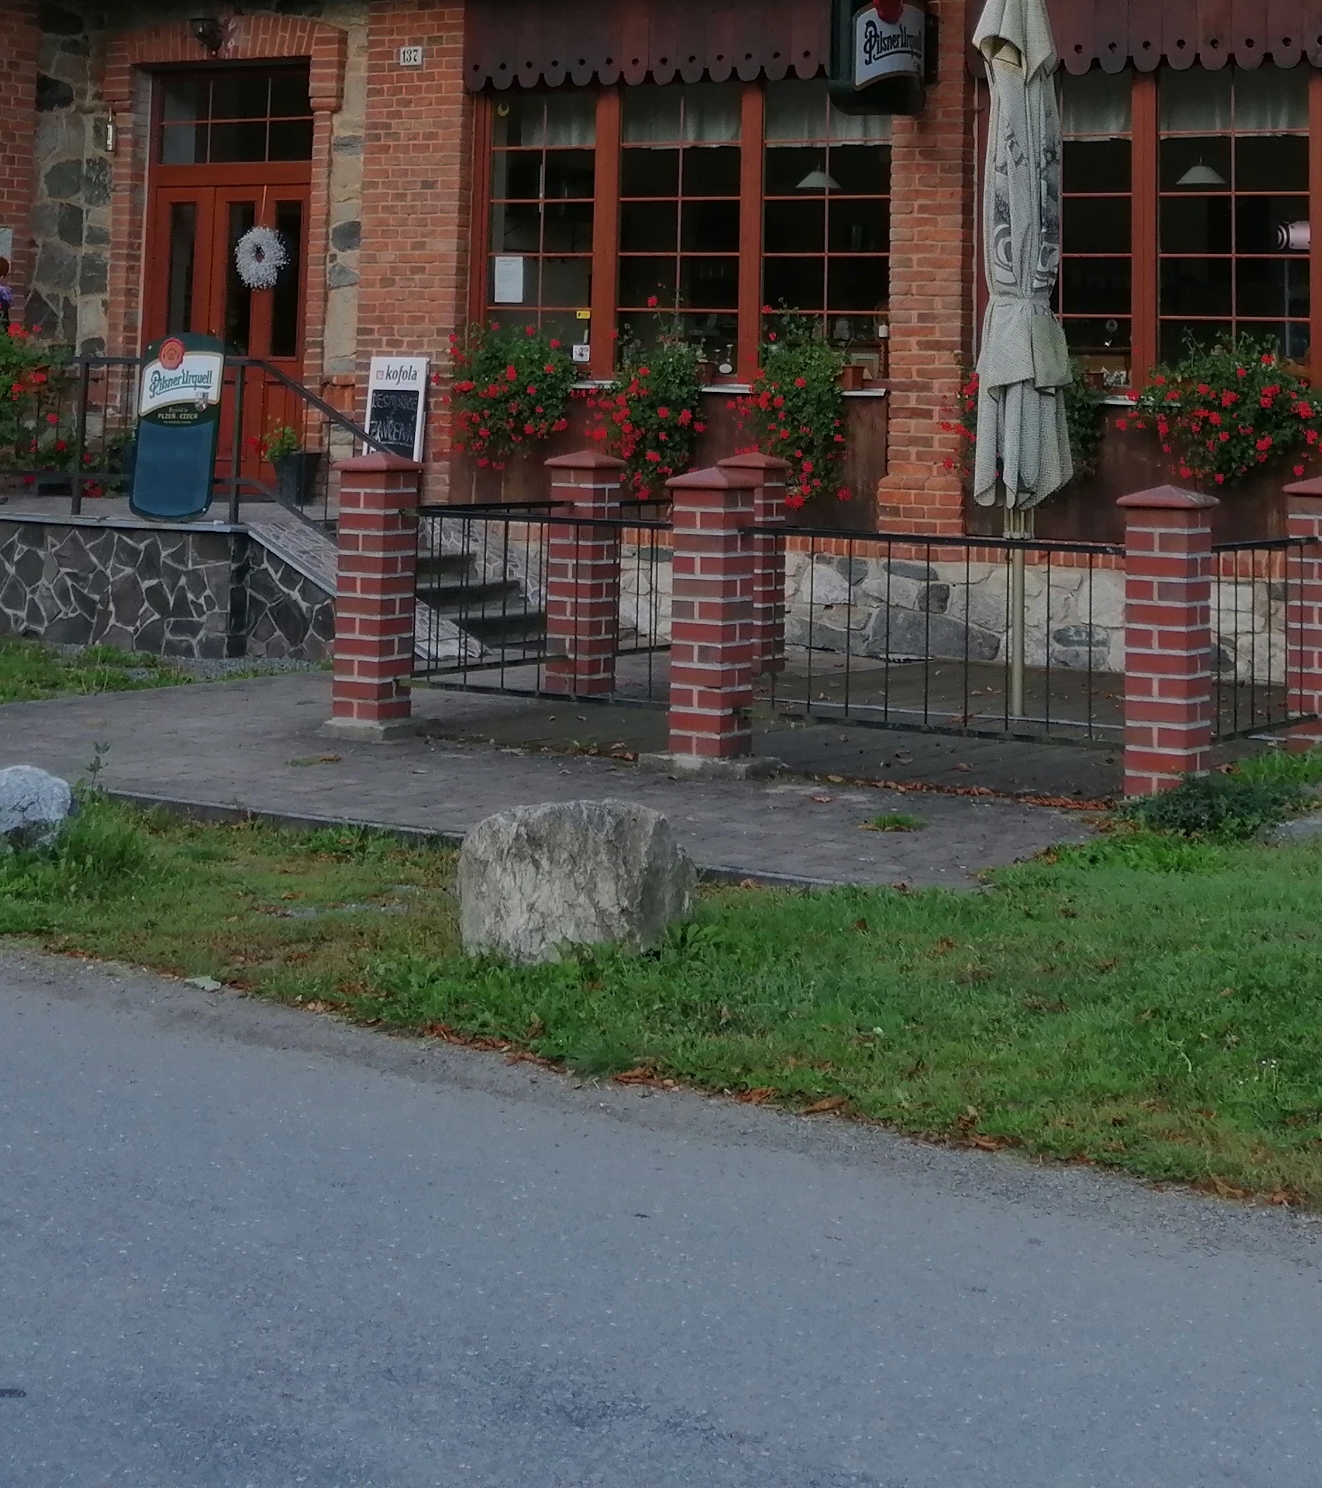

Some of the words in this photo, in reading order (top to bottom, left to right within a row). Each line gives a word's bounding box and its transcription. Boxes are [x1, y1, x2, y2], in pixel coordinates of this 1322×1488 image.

[863, 20, 900, 66] Pilsner
[402, 49, 418, 63] 137
[149, 370, 182, 399] Pilsner
[181, 369, 213, 390] Urquell
[385, 365, 418, 385] kofola
